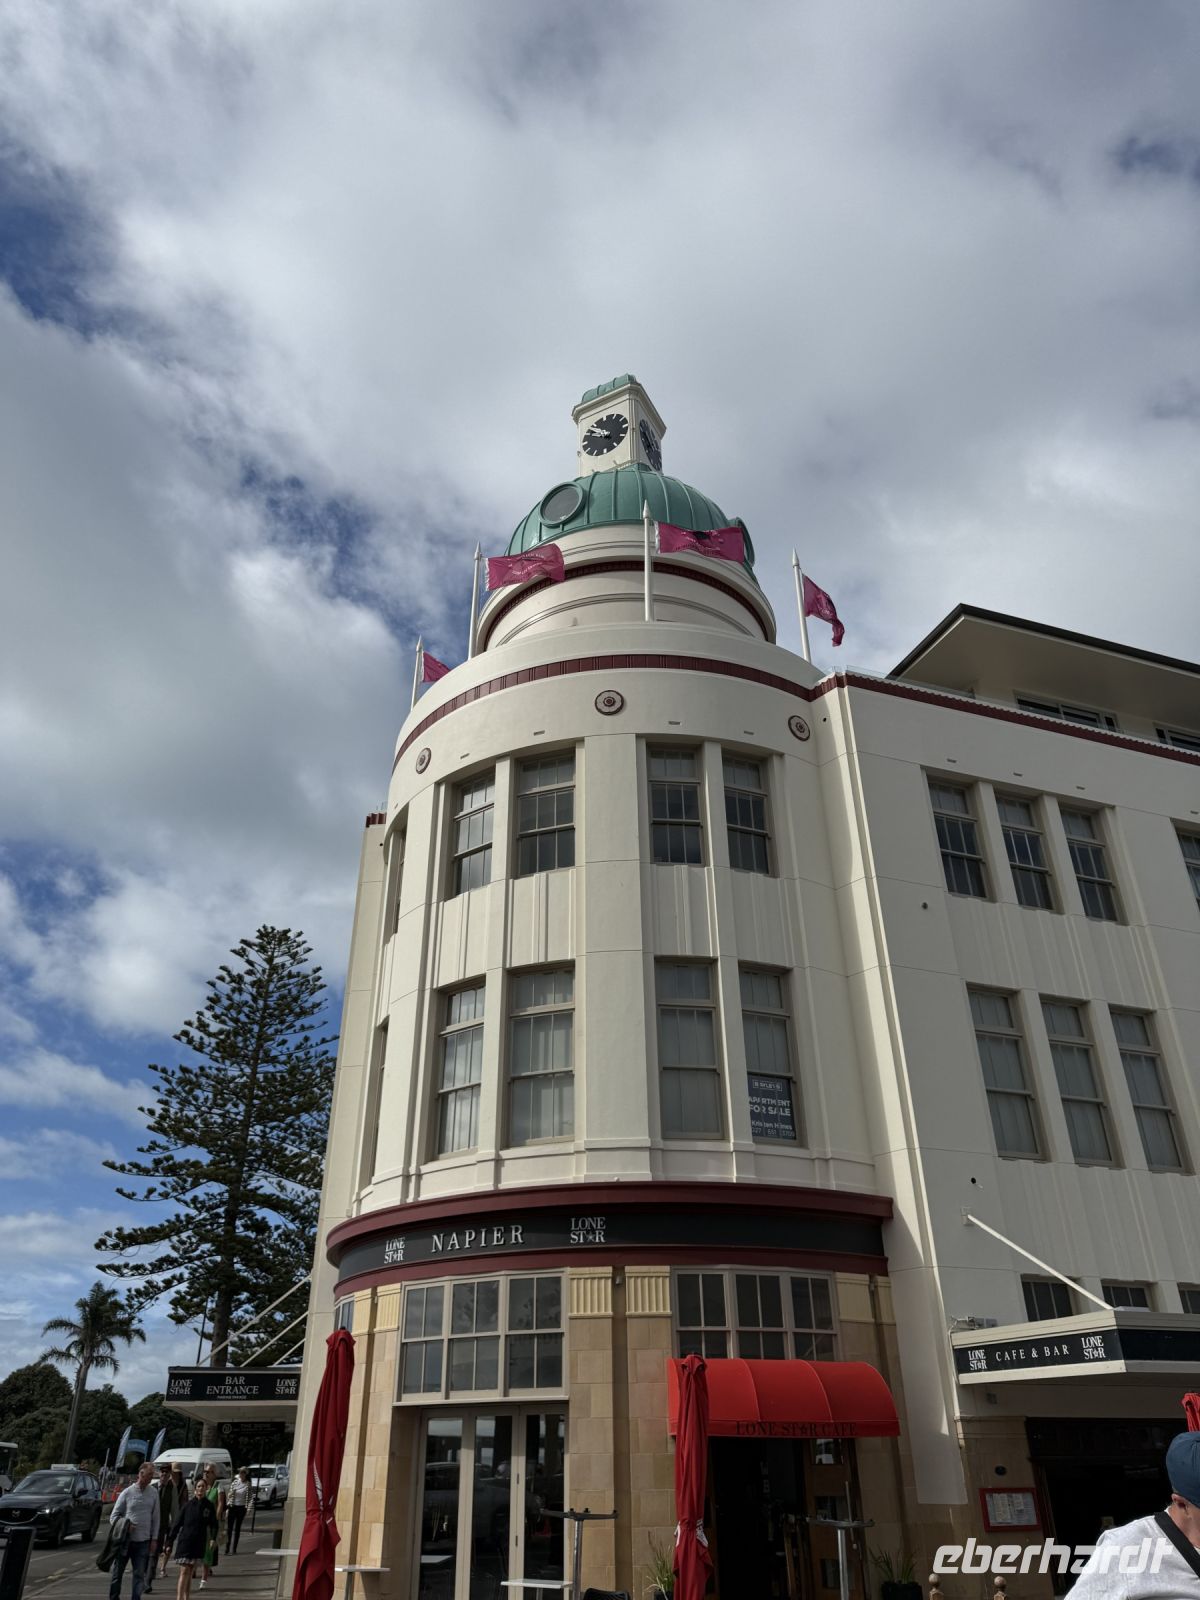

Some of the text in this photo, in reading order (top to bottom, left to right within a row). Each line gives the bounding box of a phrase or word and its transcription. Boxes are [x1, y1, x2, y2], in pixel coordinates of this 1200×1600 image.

[570, 1216, 606, 1230] LONE
[385, 1237, 406, 1252] LONE
[431, 1225, 524, 1253] NAPIER
[1081, 1336, 1104, 1349] LONE
[968, 1349, 986, 1361] LONE
[995, 1344, 1070, 1362] CAFE & BAR
[170, 1379, 192, 1387] LONE
[225, 1376, 245, 1385] BAR
[276, 1379, 298, 1387] LONE
[206, 1385, 259, 1395] ENTRANCE
[735, 1421, 775, 1436] LONE
[821, 1422, 858, 1436] CAFE
